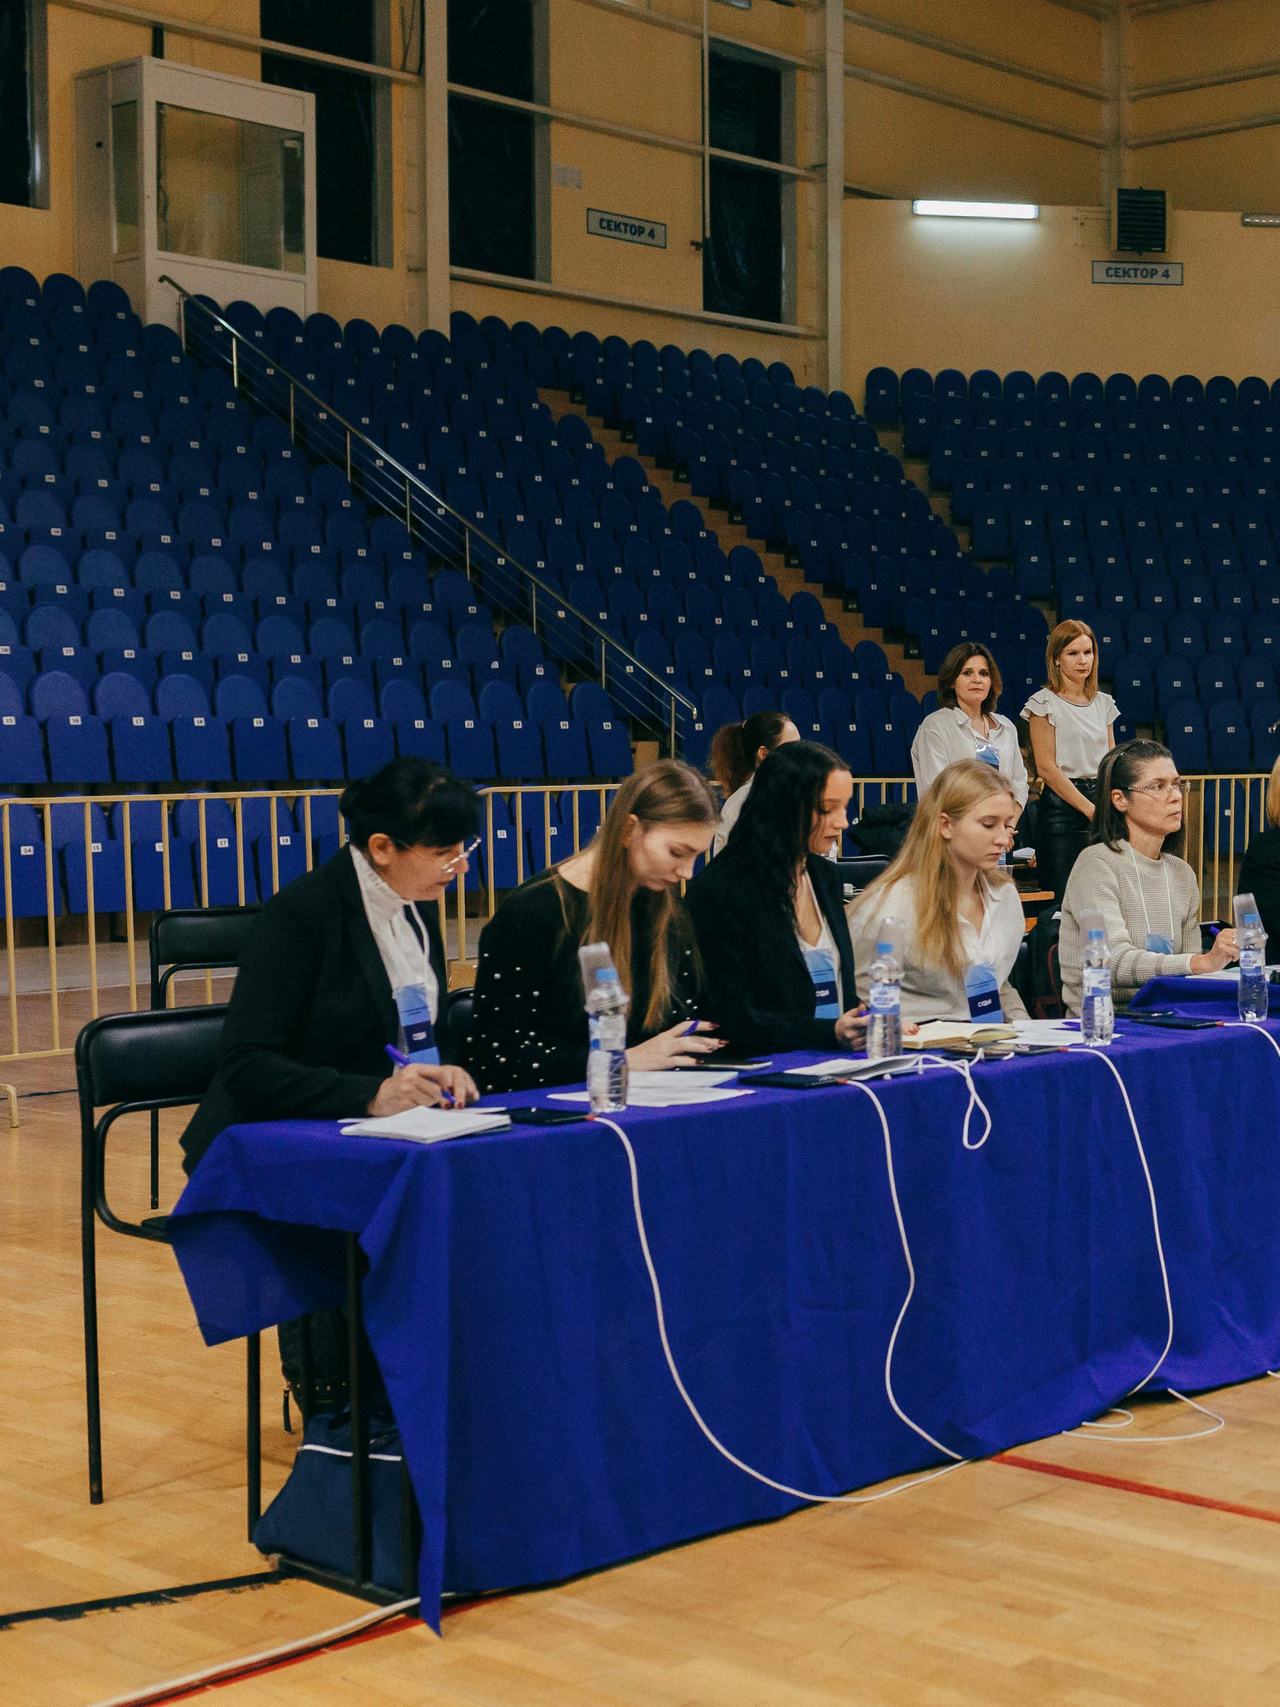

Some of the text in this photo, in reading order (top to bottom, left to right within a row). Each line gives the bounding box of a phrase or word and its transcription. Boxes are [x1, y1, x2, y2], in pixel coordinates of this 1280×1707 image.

[599, 218, 656, 239] СЕКТОР 4
[1105, 266, 1170, 279] СЕКТОР 4
